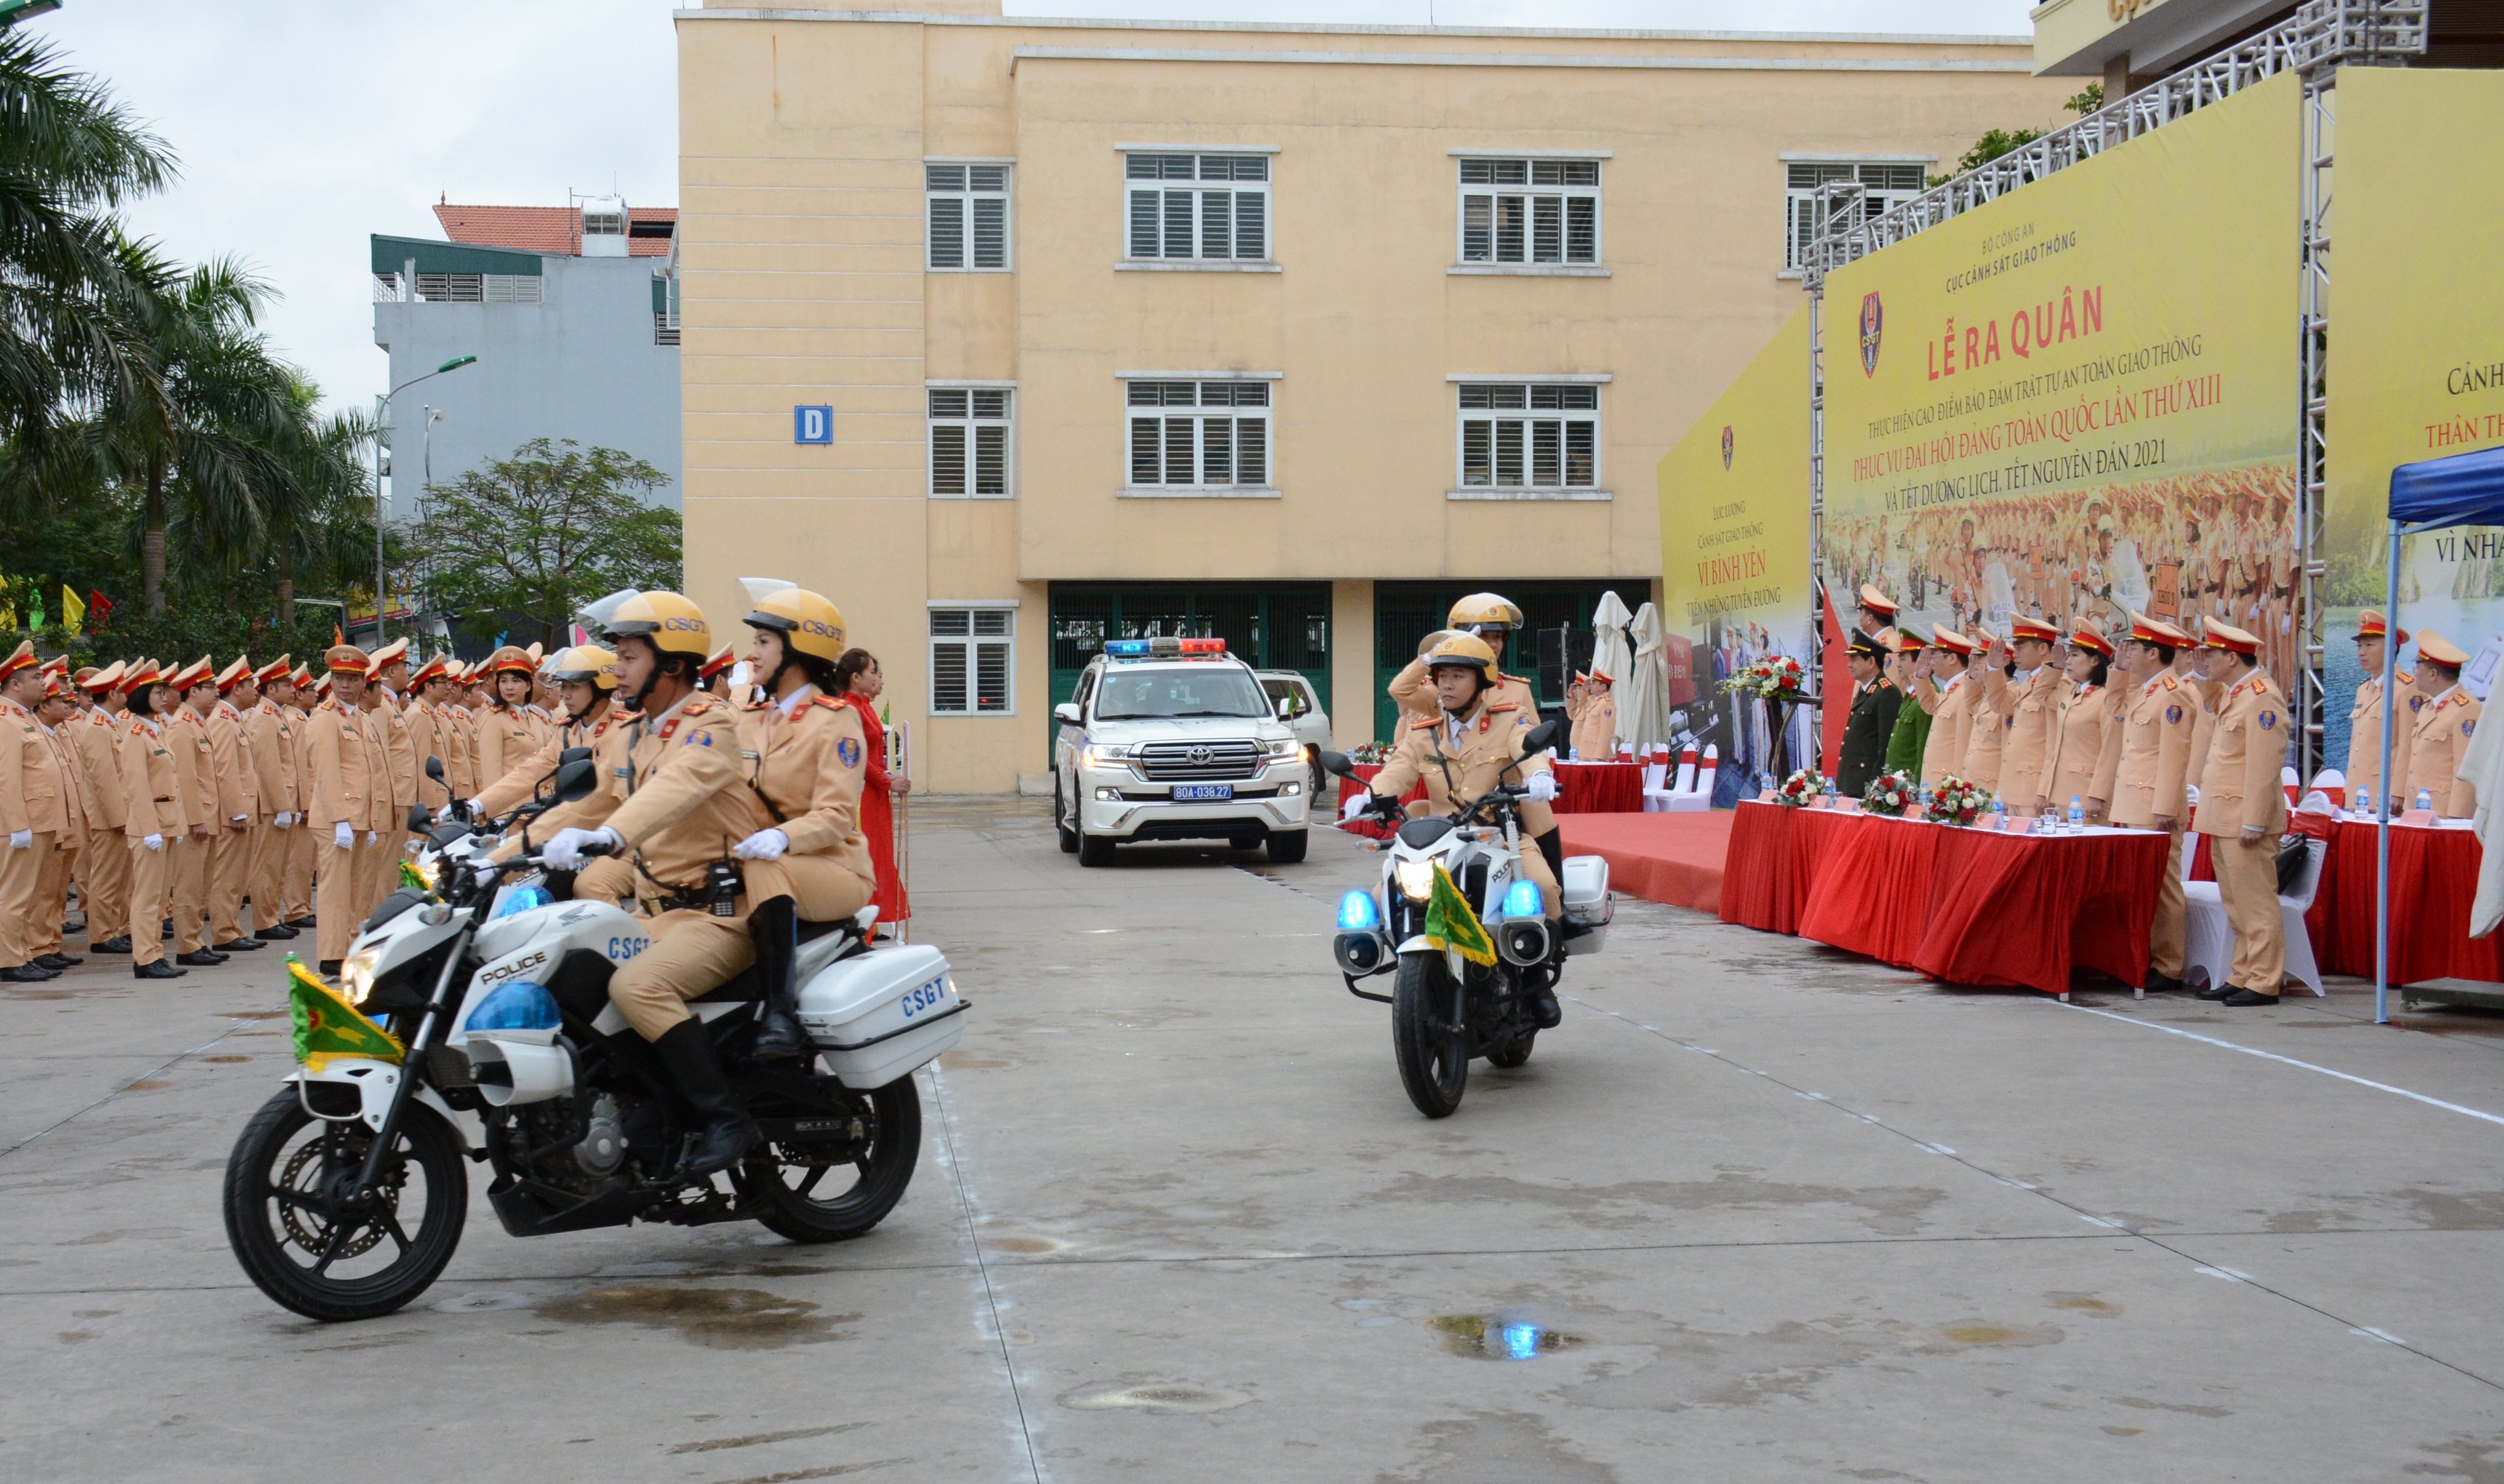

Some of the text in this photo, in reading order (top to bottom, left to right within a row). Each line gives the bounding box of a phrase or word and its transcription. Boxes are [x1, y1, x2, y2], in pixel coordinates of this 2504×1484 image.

[1982, 221, 2034, 256] BỘ CÔNG AN
[1946, 231, 2076, 295] CỤC CẢNH SÁT GIAO THÔNG
[1928, 285, 2101, 381] LỄ RA QUÂN
[1868, 334, 2201, 440] THỰC HIỆN CAO ĐIỂM BẢO ĐẢM TRẬT TỰ AN TOÀN GIAO THÔNG
[2447, 362, 2504, 395] CẢNH
[805, 409, 823, 439] D
[1854, 373, 2222, 482] PHỤC VỤ ĐẠI HỘI ĐẢNG TOÀN QUỐC LẦN THỨ XIII
[2425, 414, 2478, 448] THÂN
[1885, 486, 1898, 512] VÀ
[1900, 479, 1919, 509] TẾT
[1922, 476, 1965, 506] DƯƠNG
[2005, 456, 2029, 490] TẾT
[2032, 448, 2092, 486] NGUYÊN
[2096, 441, 2129, 475] ĐÁN
[2134, 438, 2166, 468] 2021
[1726, 528, 1740, 543] GIAO
[1741, 521, 1763, 539] THÔNG
[2436, 529, 2456, 562] VÌ
[1697, 544, 1766, 586] VÌ BÌNH YÊN
[1687, 598, 1703, 617] TRÊN
[665, 617, 706, 634] CSGT
[803, 620, 842, 642] CSGT
[1175, 786, 1229, 798] 80A-038.27
[561, 913, 598, 927] HONDA
[480, 951, 547, 985] POLICE
[902, 977, 944, 1017] CSGT
